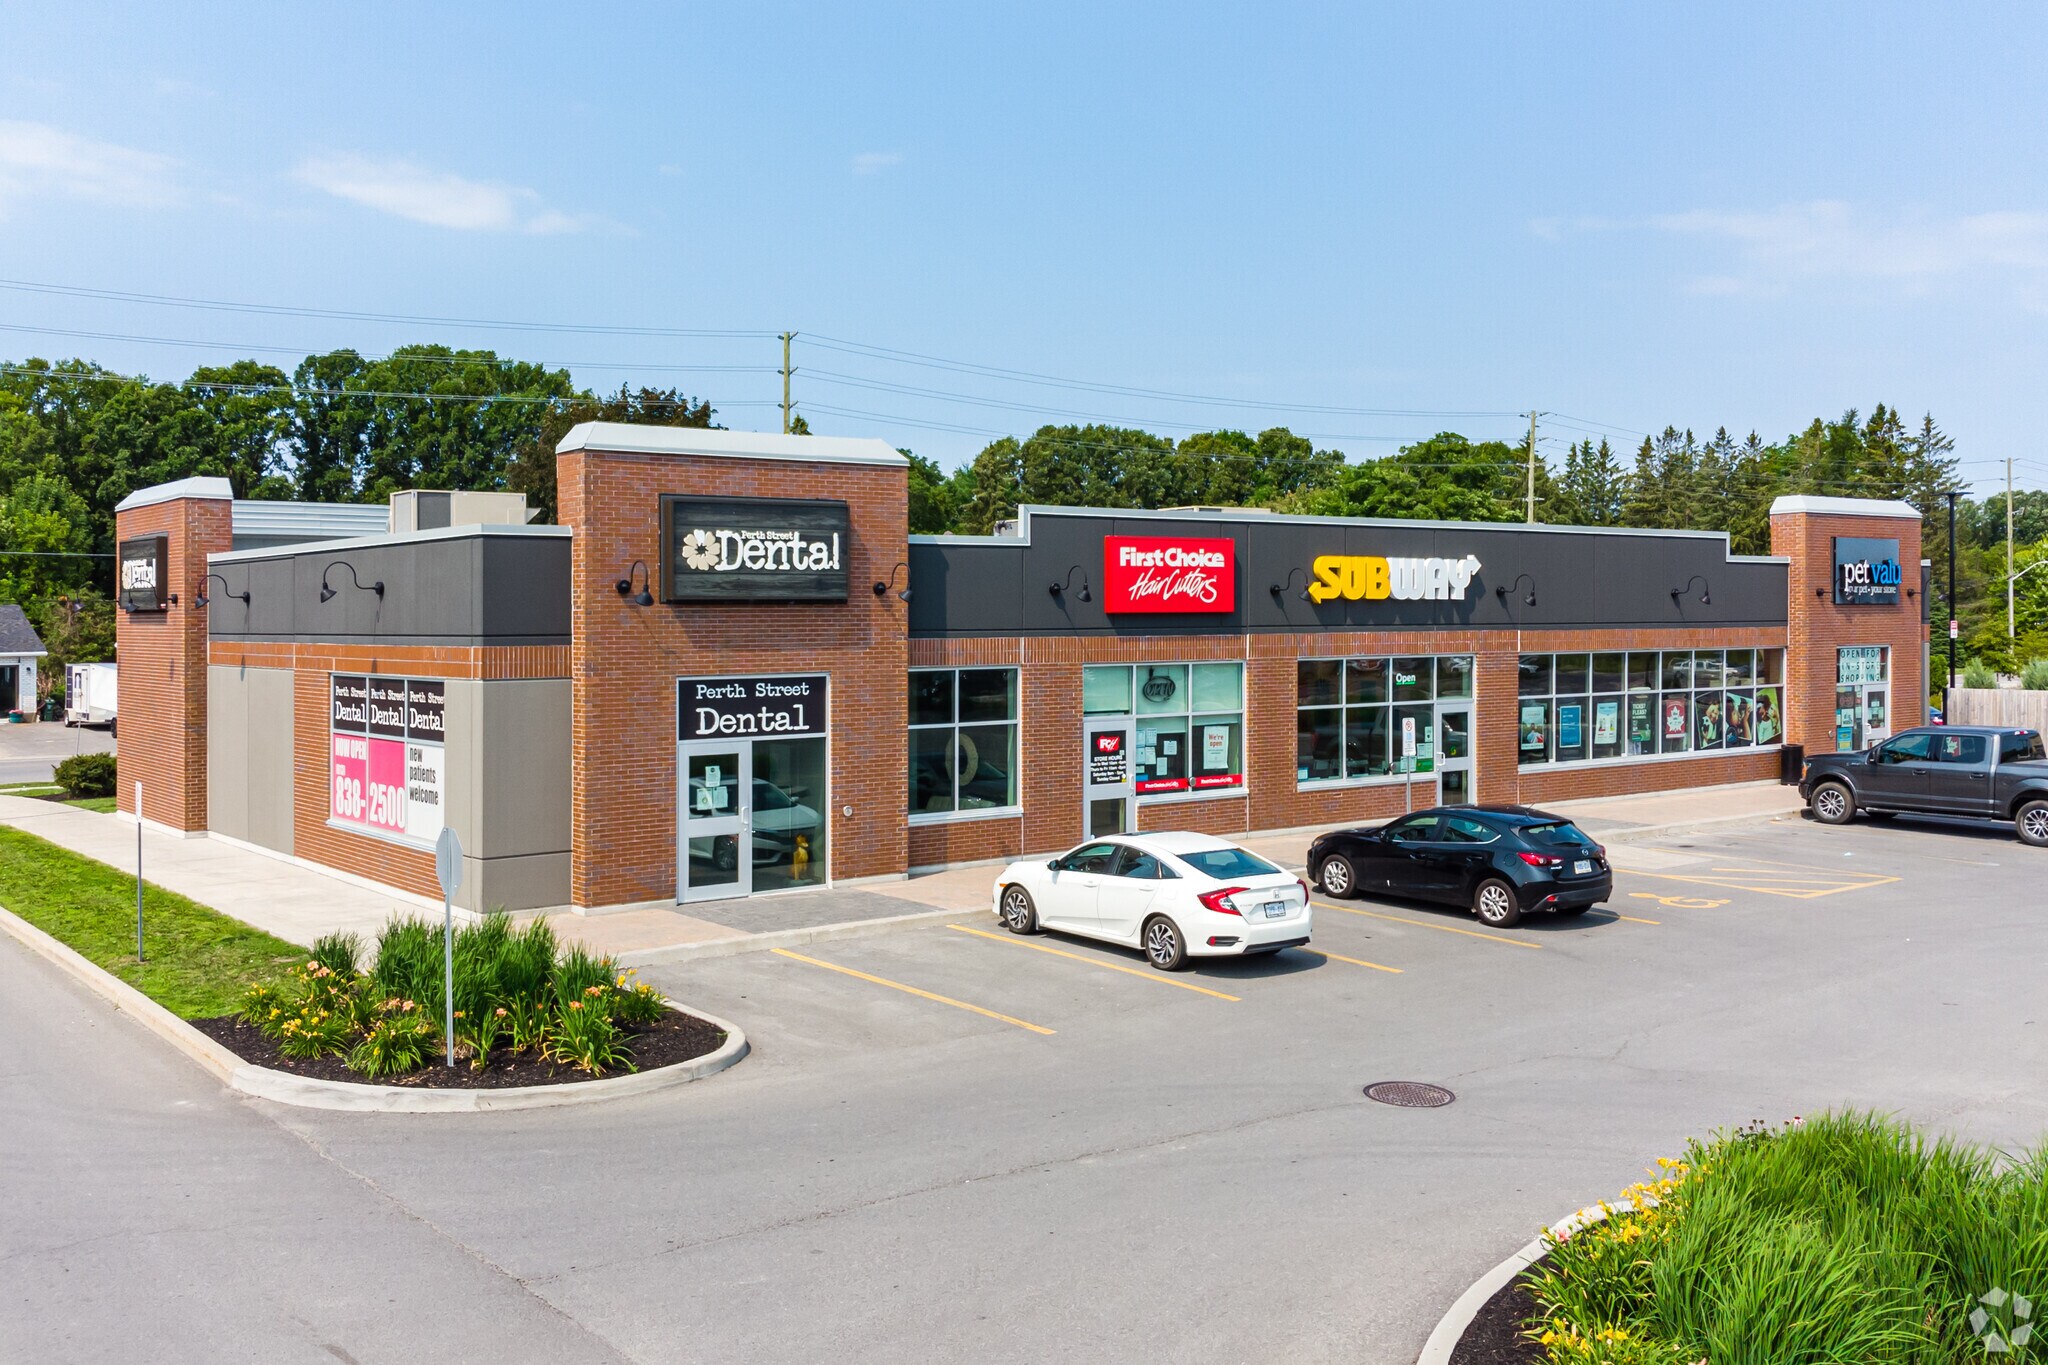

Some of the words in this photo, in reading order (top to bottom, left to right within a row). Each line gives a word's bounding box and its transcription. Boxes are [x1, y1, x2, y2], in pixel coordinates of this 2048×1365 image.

[741, 530, 766, 540] Perth
[766, 530, 794, 540] Street
[714, 530, 840, 571] Dental
[1120, 546, 1164, 566] First
[1164, 548, 1224, 568] Choice
[1308, 554, 1482, 604] SUBWAY
[1844, 560, 1870, 592] pet
[1871, 558, 1902, 585] valu
[1841, 650, 1860, 658] OPEN
[1866, 650, 1880, 658] FOR
[1396, 673, 1416, 684] Open
[1840, 674, 1880, 682] SHOPPING
[335, 686, 349, 697] Perth
[350, 686, 366, 698] Street
[371, 688, 386, 700] Perth
[387, 690, 405, 702] Street
[410, 691, 426, 703] Perth
[696, 684, 746, 699] Perth
[756, 682, 810, 697] Street
[335, 701, 366, 722] Dental
[371, 704, 405, 727] Dental
[410, 708, 445, 732] Dental
[696, 704, 810, 735] Dental
[410, 747, 423, 763] new
[409, 766, 436, 784] patients
[336, 776, 366, 818] 838-
[369, 782, 405, 829] 2500
[409, 786, 439, 806] welcome
